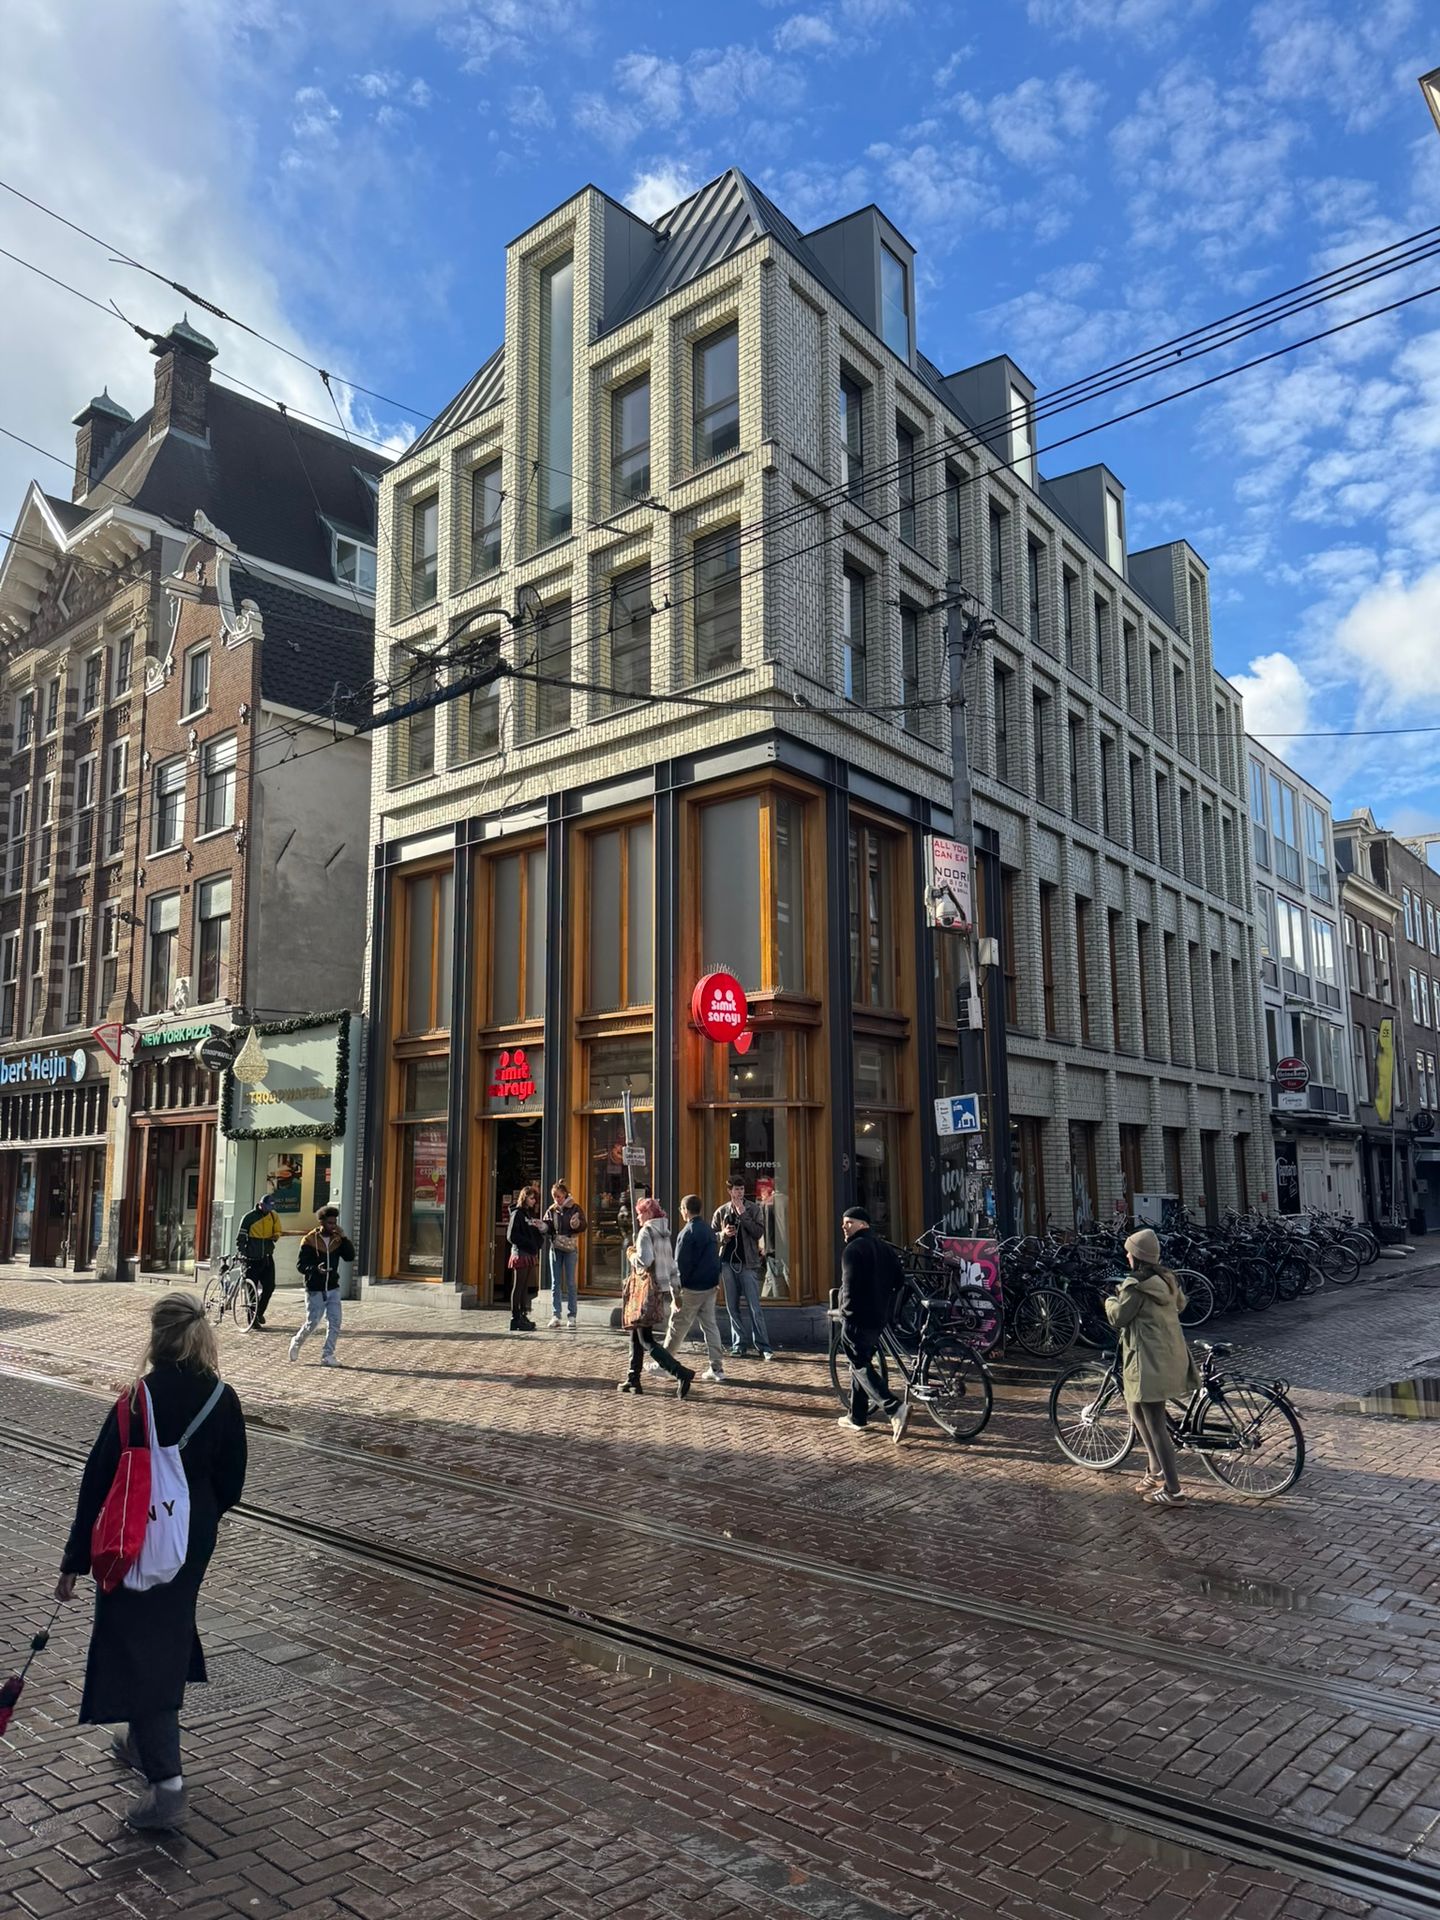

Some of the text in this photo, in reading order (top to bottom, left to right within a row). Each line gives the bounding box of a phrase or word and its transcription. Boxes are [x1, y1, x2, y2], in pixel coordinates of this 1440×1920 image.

[934, 840, 968, 854] ALL YOU
[934, 850, 968, 863] CAN EAT
[936, 877, 969, 889] FSION
[142, 1032, 161, 1047] NEW
[163, 1027, 187, 1044] YORK
[185, 1023, 212, 1041] PIZZA
[0, 1049, 67, 1087] bert Heijn
[745, 1161, 782, 1171] express
